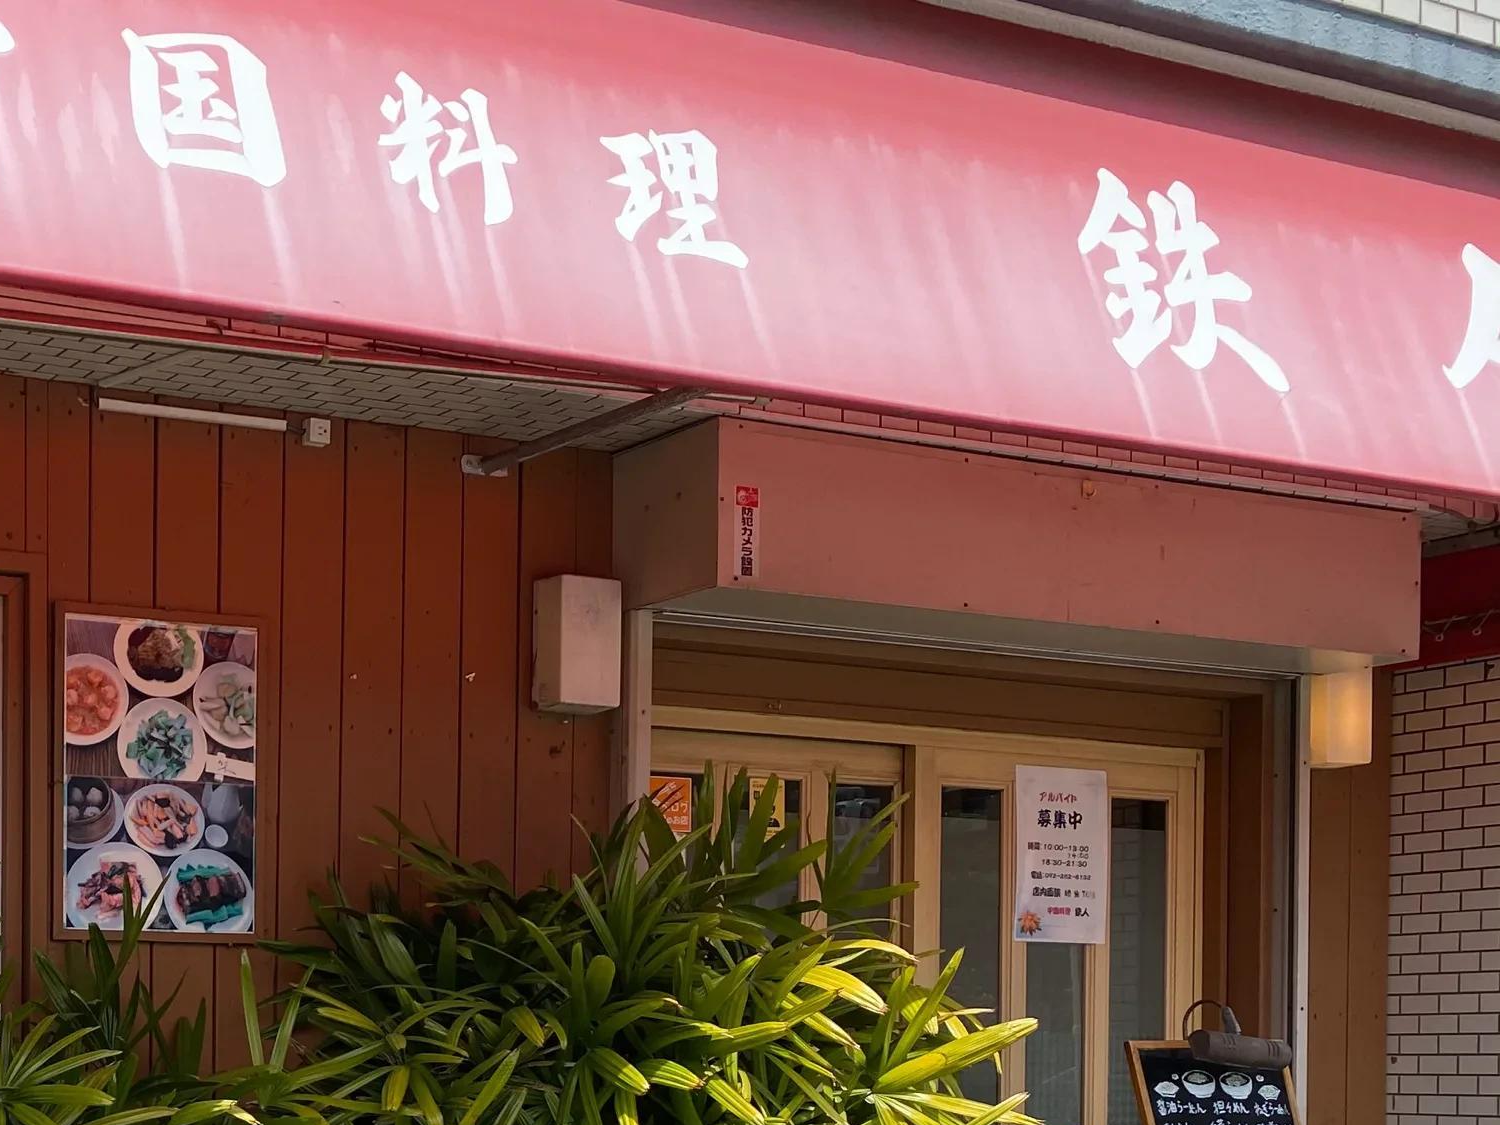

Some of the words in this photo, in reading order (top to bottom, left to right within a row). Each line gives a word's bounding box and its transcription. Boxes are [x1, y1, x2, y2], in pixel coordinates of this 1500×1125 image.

[1039, 791, 1078, 803] アルバイト
[1037, 808, 1083, 830] 募集中
